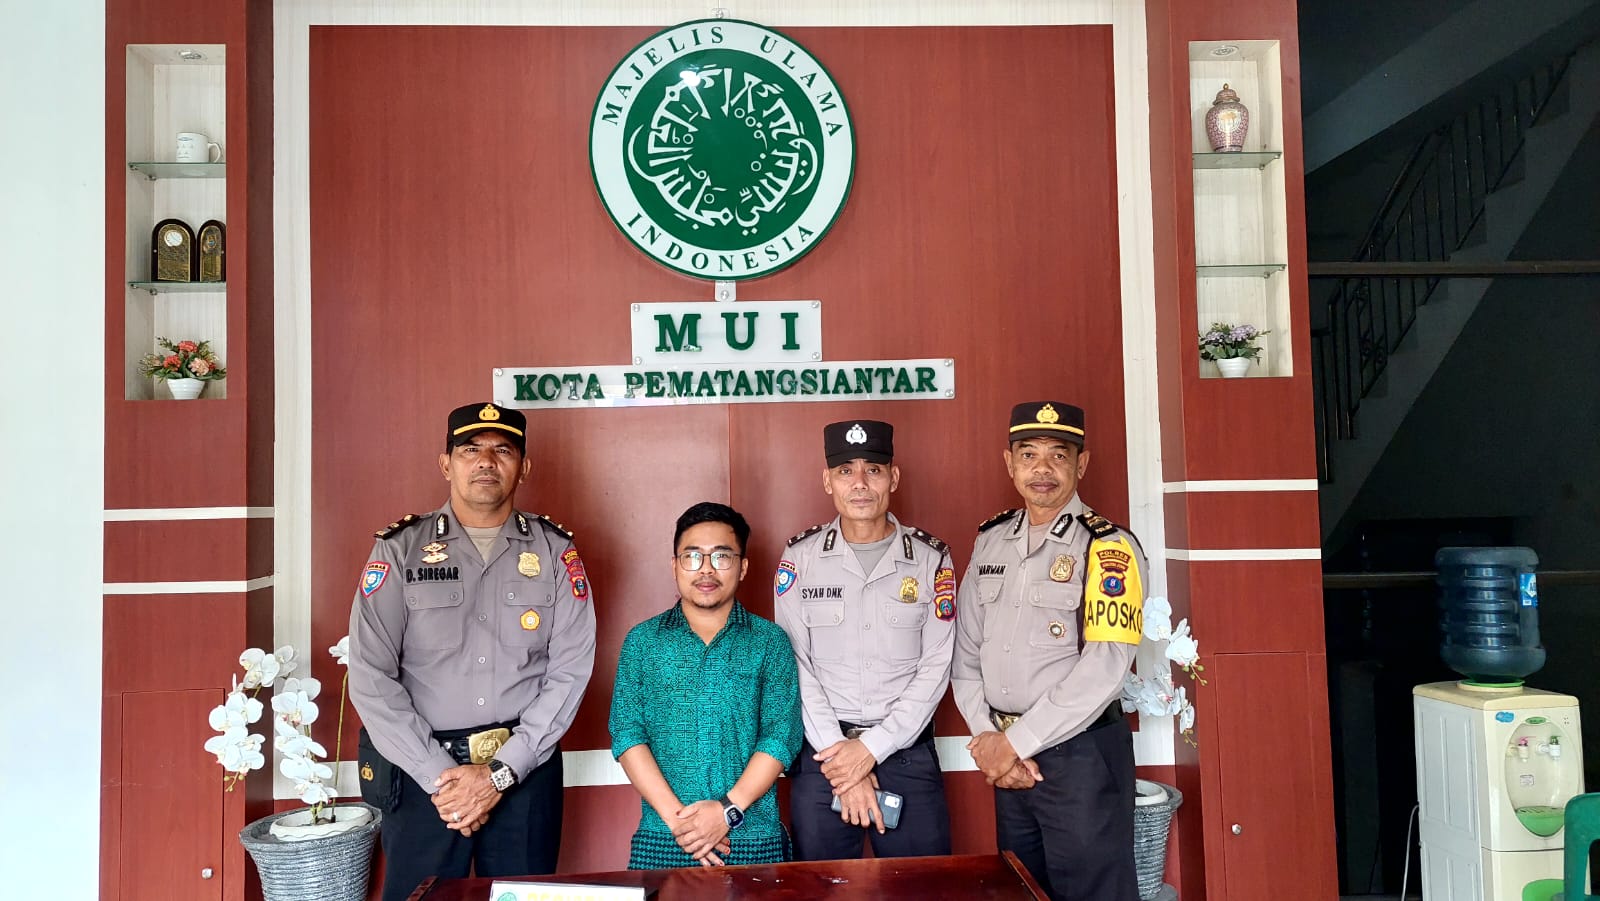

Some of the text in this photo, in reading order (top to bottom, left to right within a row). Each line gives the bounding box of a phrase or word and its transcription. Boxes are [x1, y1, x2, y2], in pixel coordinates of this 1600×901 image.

[601, 26, 844, 137] MAJELIS ULAMA
[626, 211, 814, 272] INDONESIA
[653, 311, 801, 353] MUI
[513, 366, 939, 401] KOTA PEMATANGSIANTAR
[405, 566, 459, 583] D. SIREGAR
[801, 587, 825, 599] SYAH
[1084, 599, 1142, 635] APOSKO
